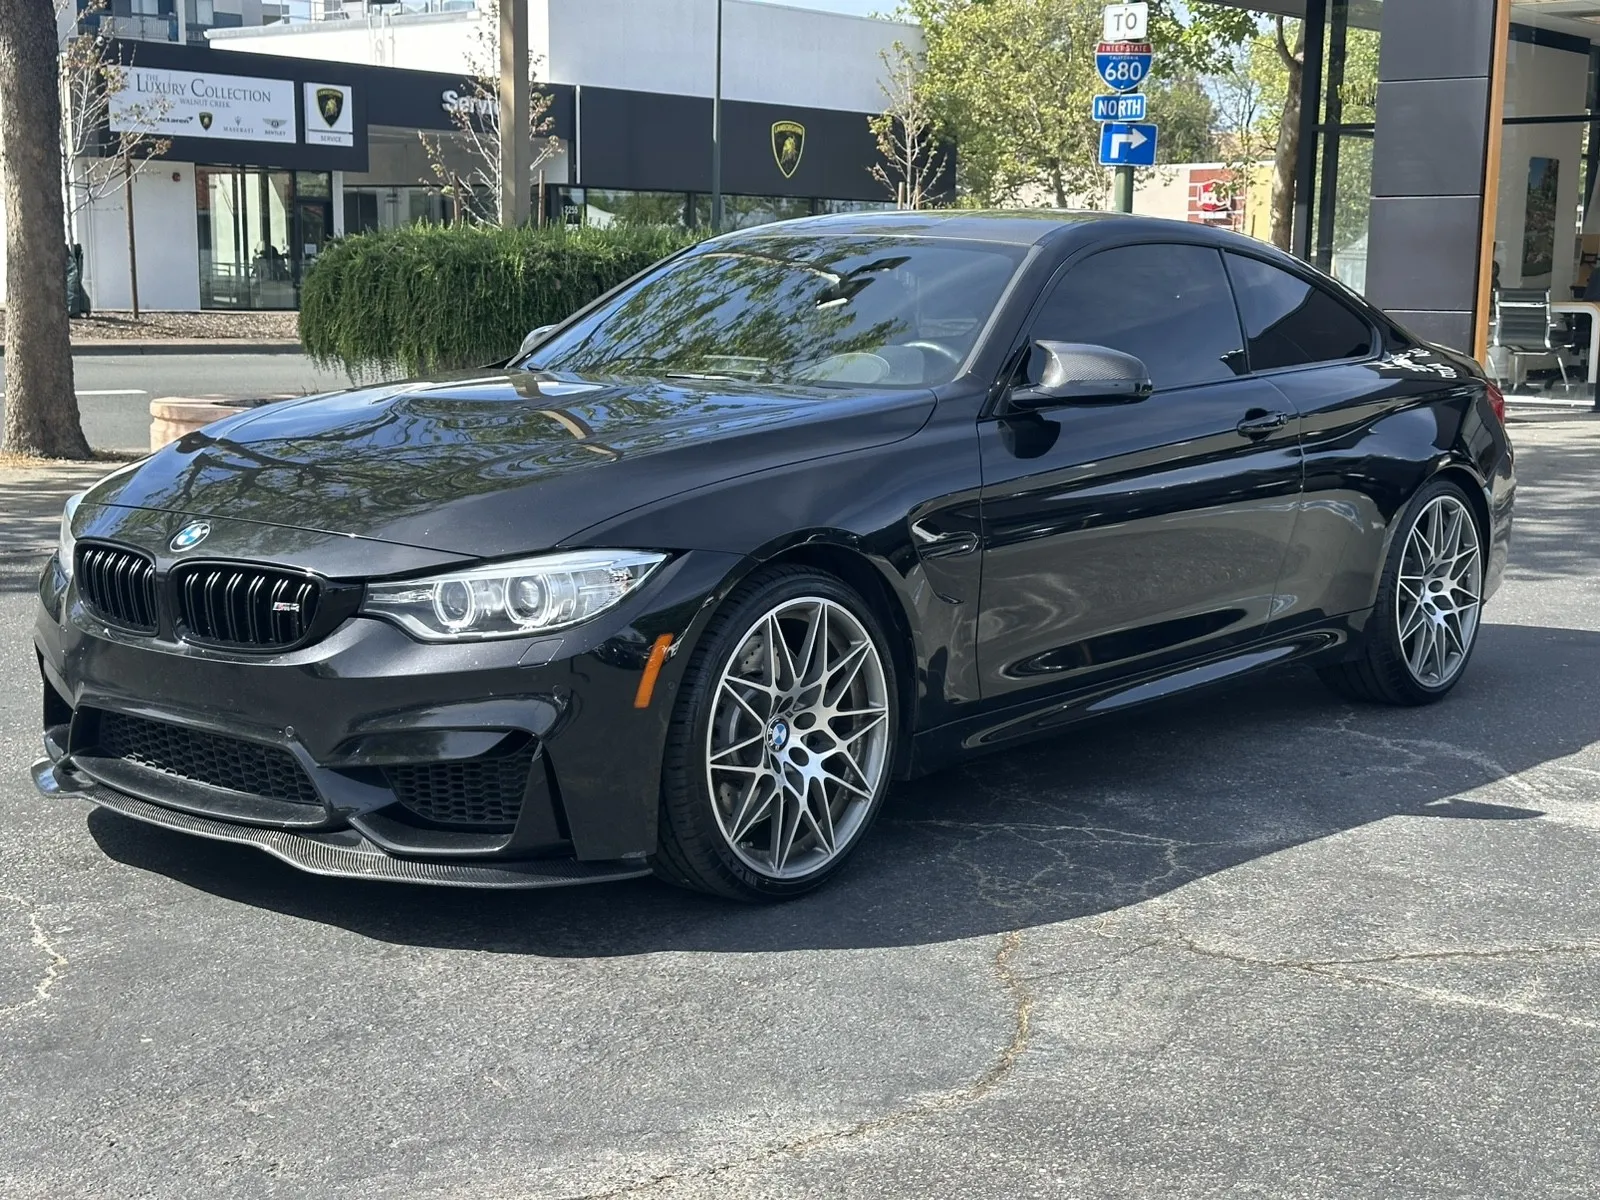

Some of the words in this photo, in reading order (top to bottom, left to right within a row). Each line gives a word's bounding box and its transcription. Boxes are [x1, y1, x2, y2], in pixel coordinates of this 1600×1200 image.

[1113, 12, 1137, 31] TO
[1102, 45, 1147, 53] INTERSTATE
[1105, 61, 1142, 81] 680
[210, 100, 231, 108] CREEK
[1098, 99, 1141, 116] NORTH
[320, 135, 342, 143] SERVICE
